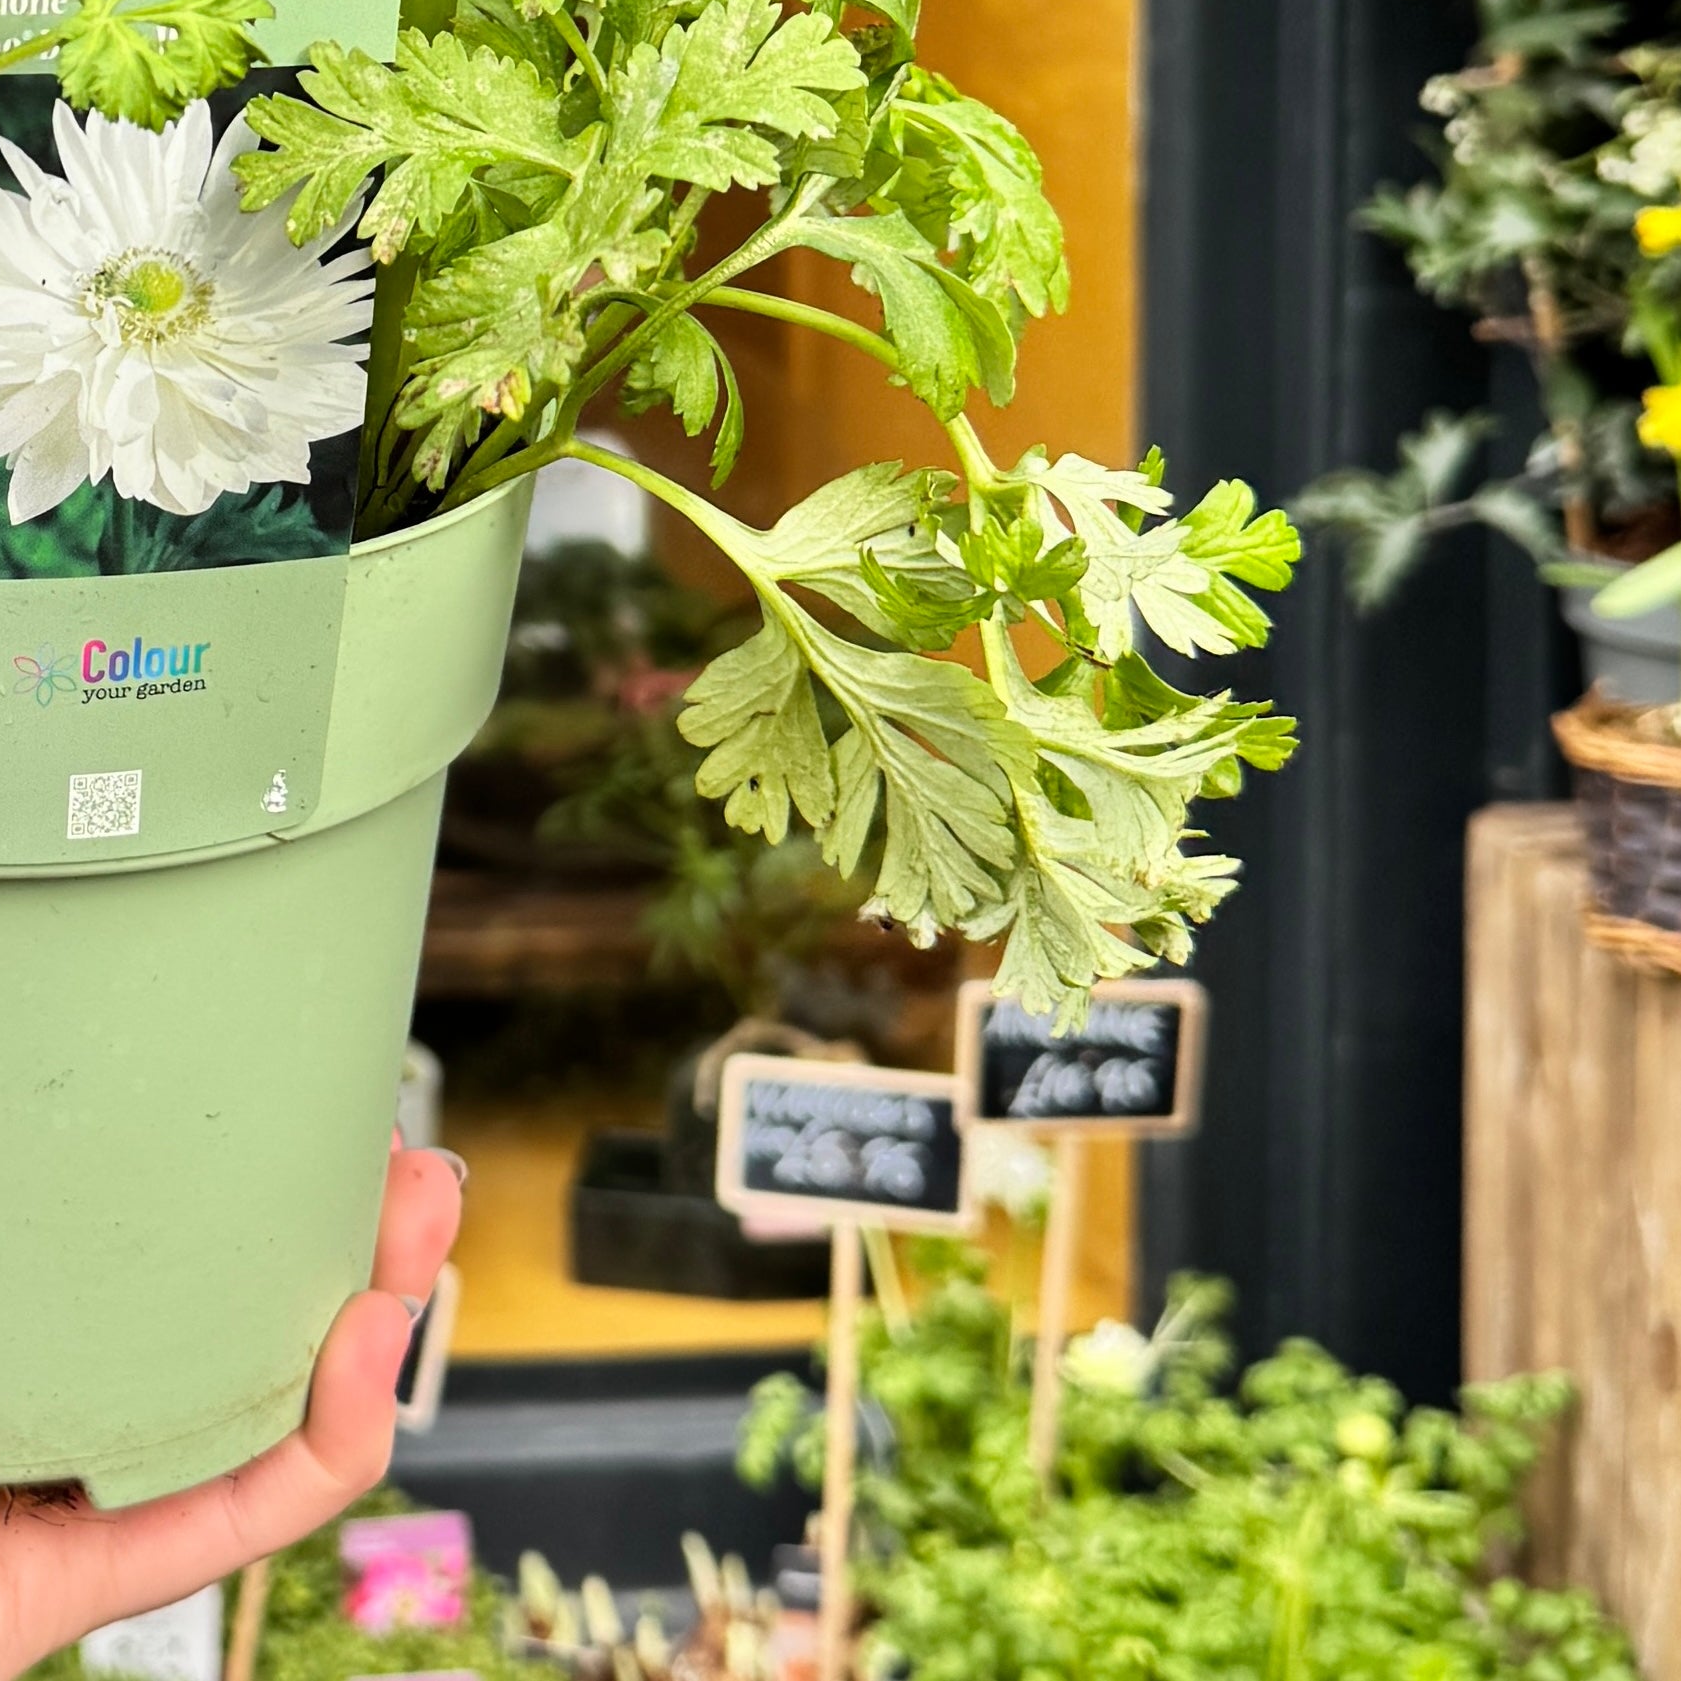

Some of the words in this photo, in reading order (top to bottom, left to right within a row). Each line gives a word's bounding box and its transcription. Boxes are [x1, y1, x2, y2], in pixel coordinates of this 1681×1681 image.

[81, 636, 211, 684] Colour
[81, 684, 132, 705] your
[135, 678, 207, 700] garden
